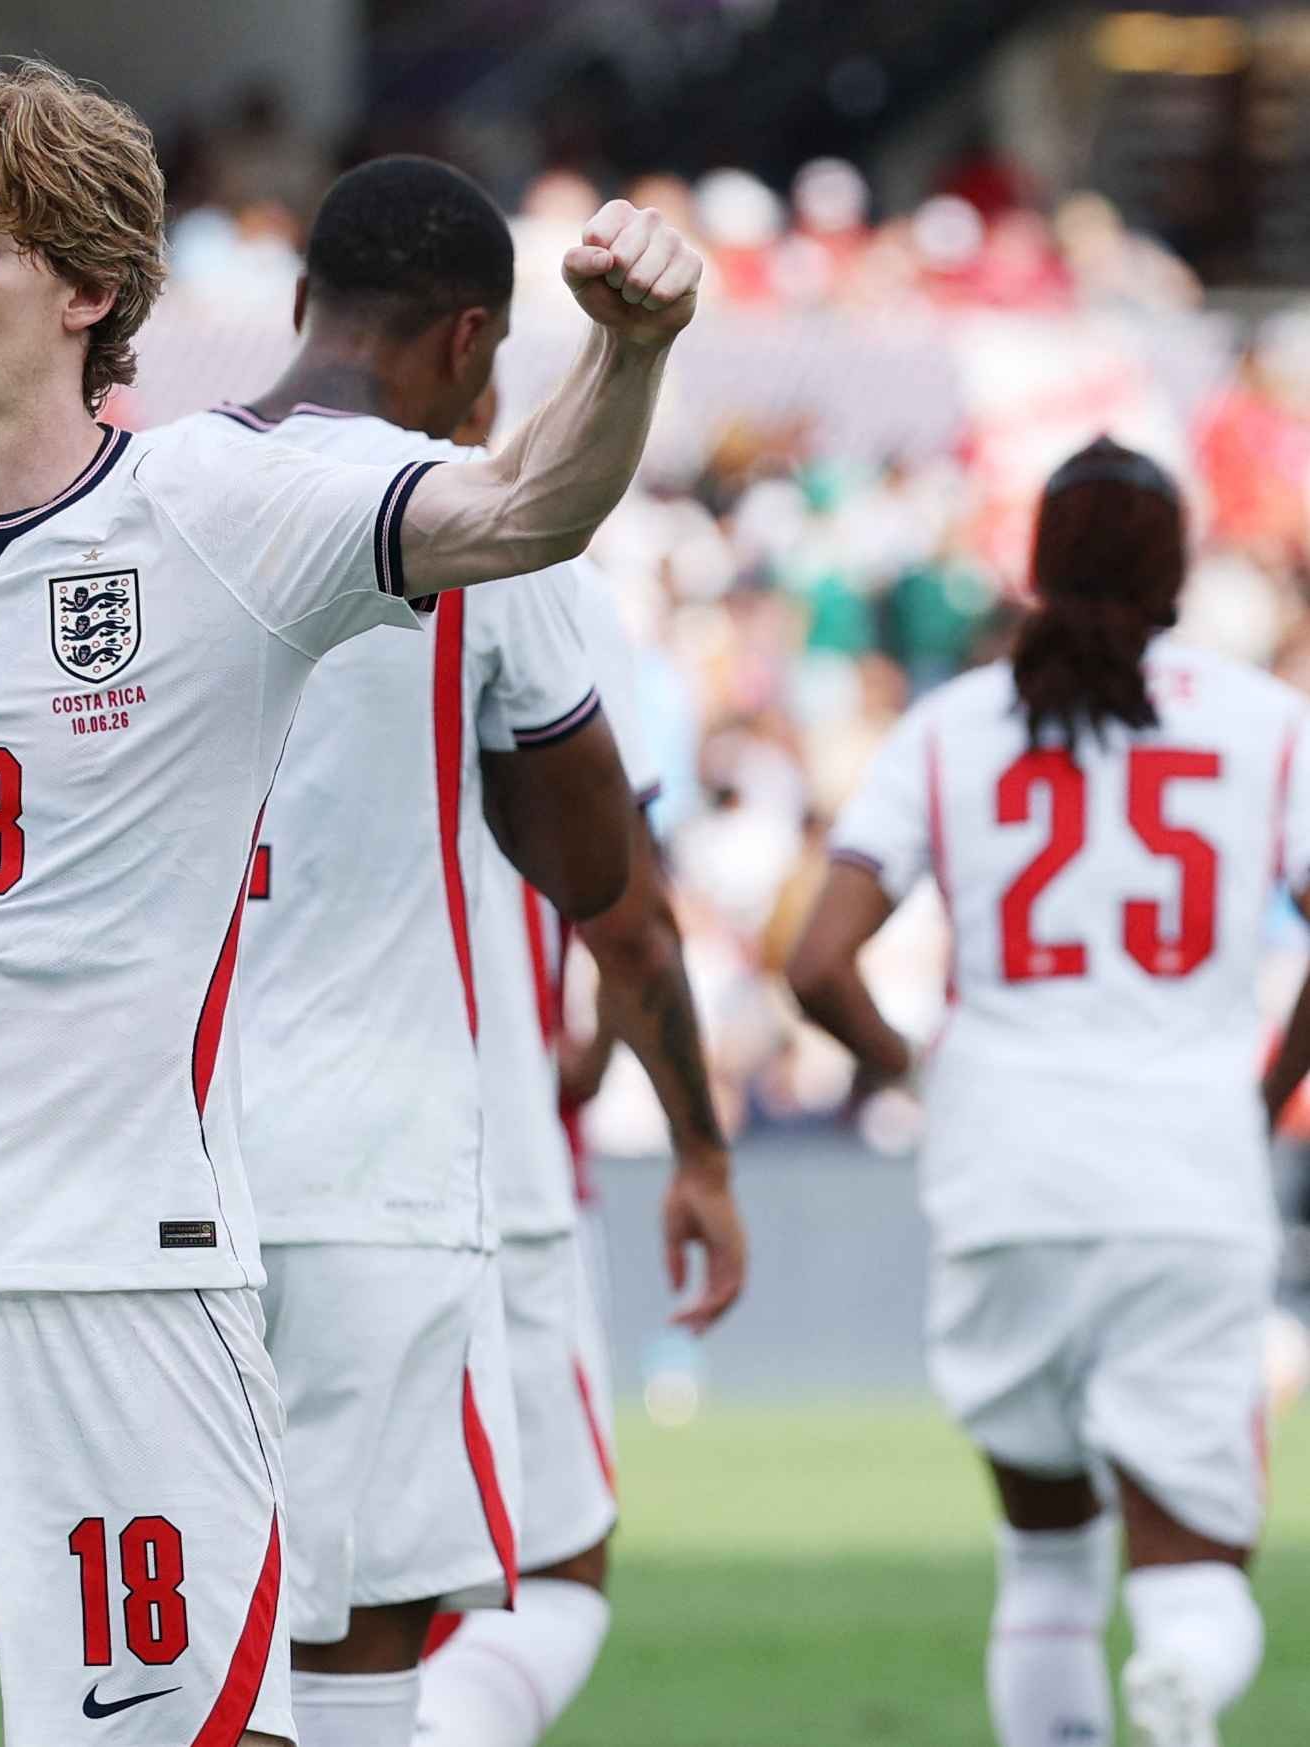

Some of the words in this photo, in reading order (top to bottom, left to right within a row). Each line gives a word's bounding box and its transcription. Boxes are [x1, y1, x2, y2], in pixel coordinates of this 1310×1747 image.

[52, 692, 103, 714] COSTA
[107, 685, 146, 708] RICA
[72, 711, 129, 735] 10.06.26
[996, 744, 1221, 985] 25
[68, 1515, 189, 1666] 18
